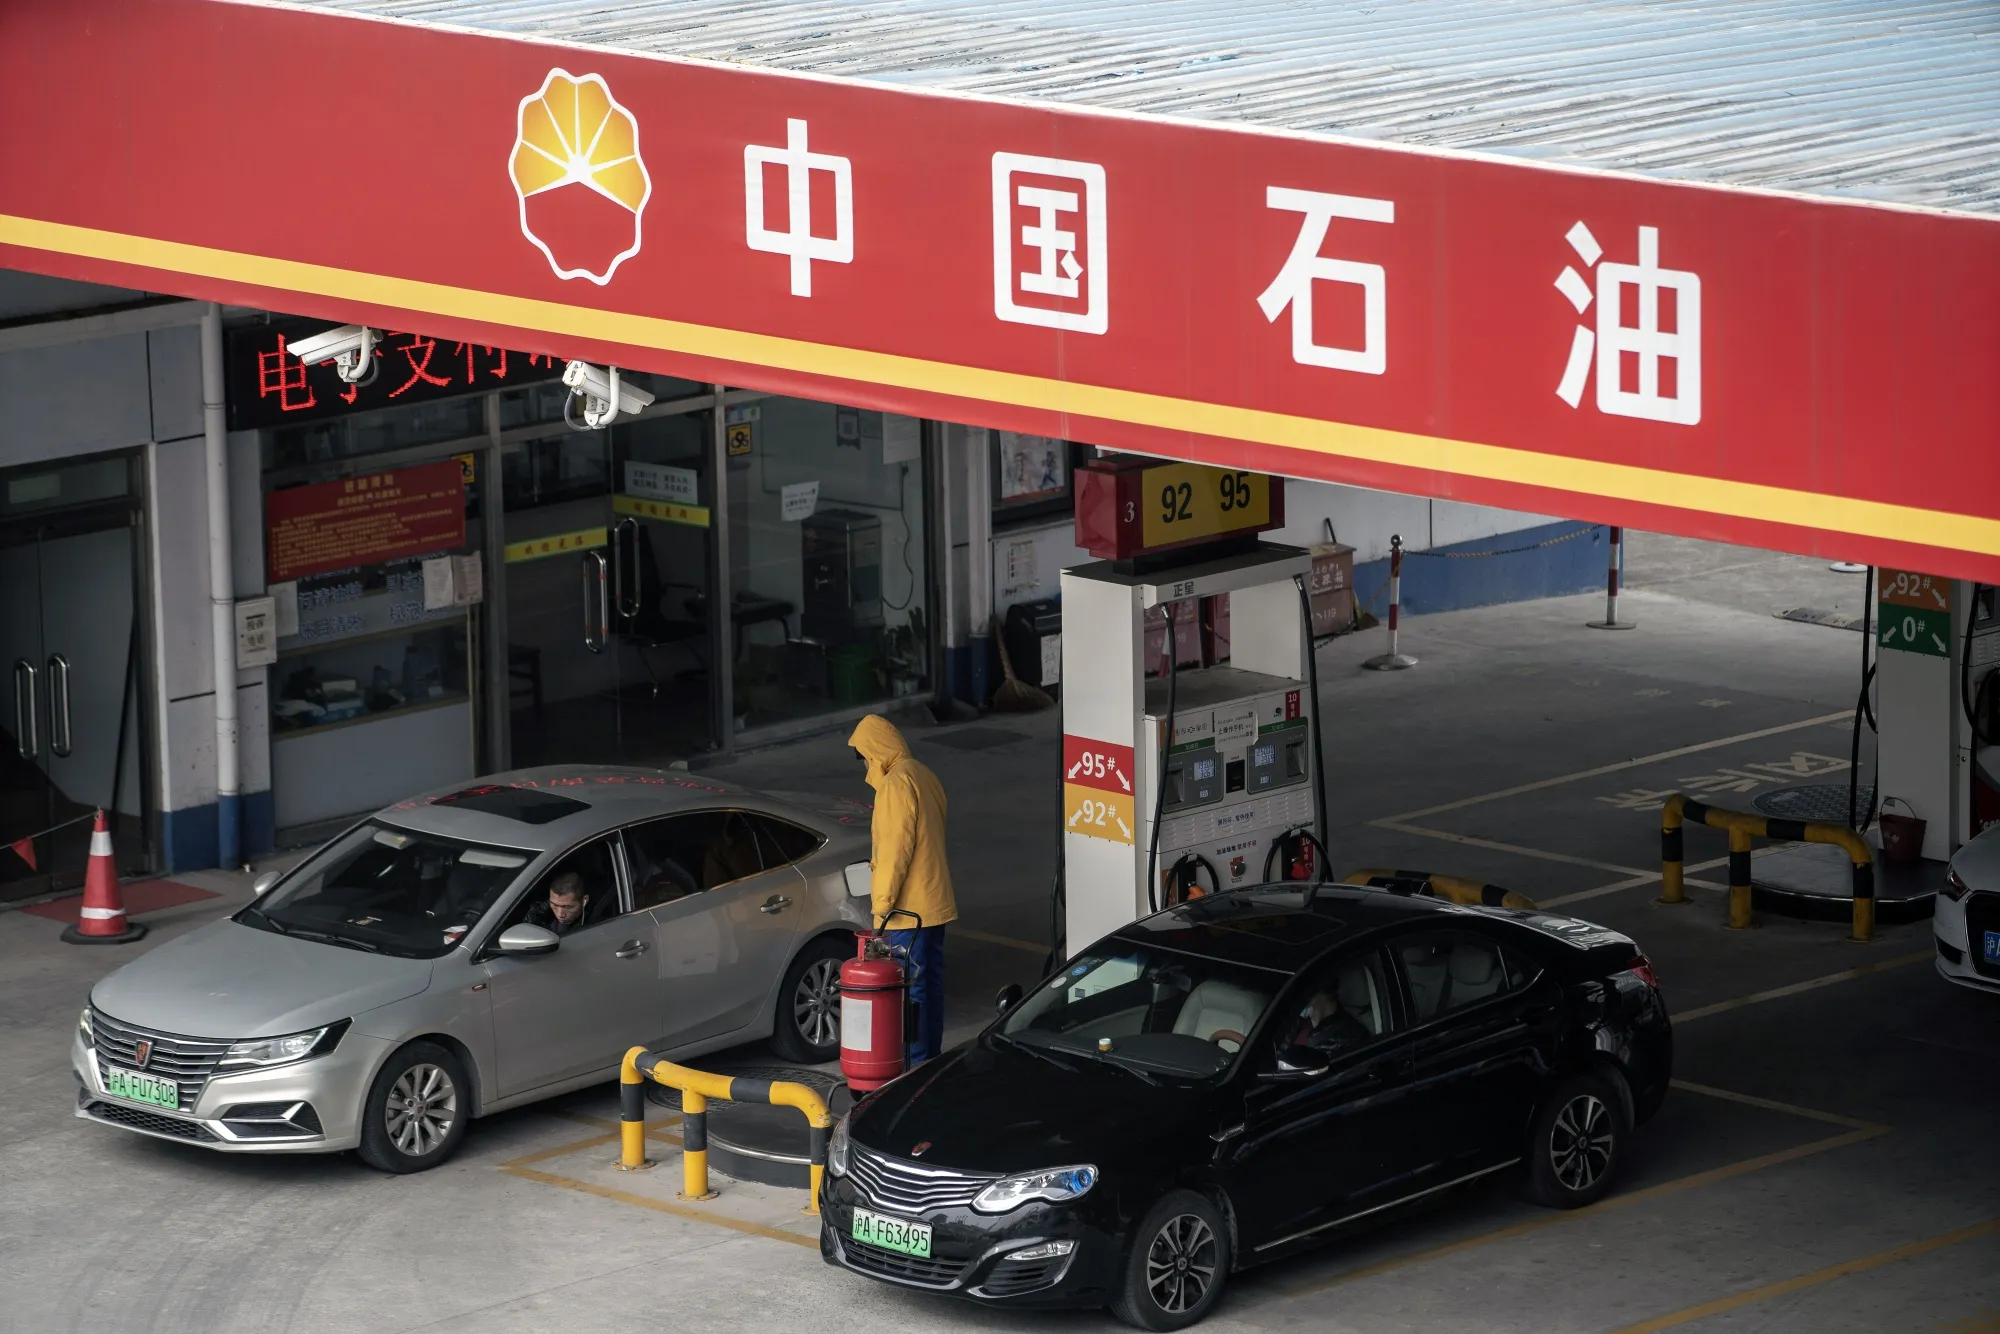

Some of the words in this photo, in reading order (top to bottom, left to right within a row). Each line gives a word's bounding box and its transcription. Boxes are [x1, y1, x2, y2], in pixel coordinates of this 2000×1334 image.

[744, 118, 1702, 426] 中国石油
[1161, 482, 1193, 524] 92
[1220, 472, 1251, 512] 95
[1124, 501, 1135, 523] 3
[1897, 572, 1932, 597] 92#
[1902, 615, 1927, 642] 0#
[1082, 751, 1116, 778] 95#
[1083, 799, 1116, 826] 92#
